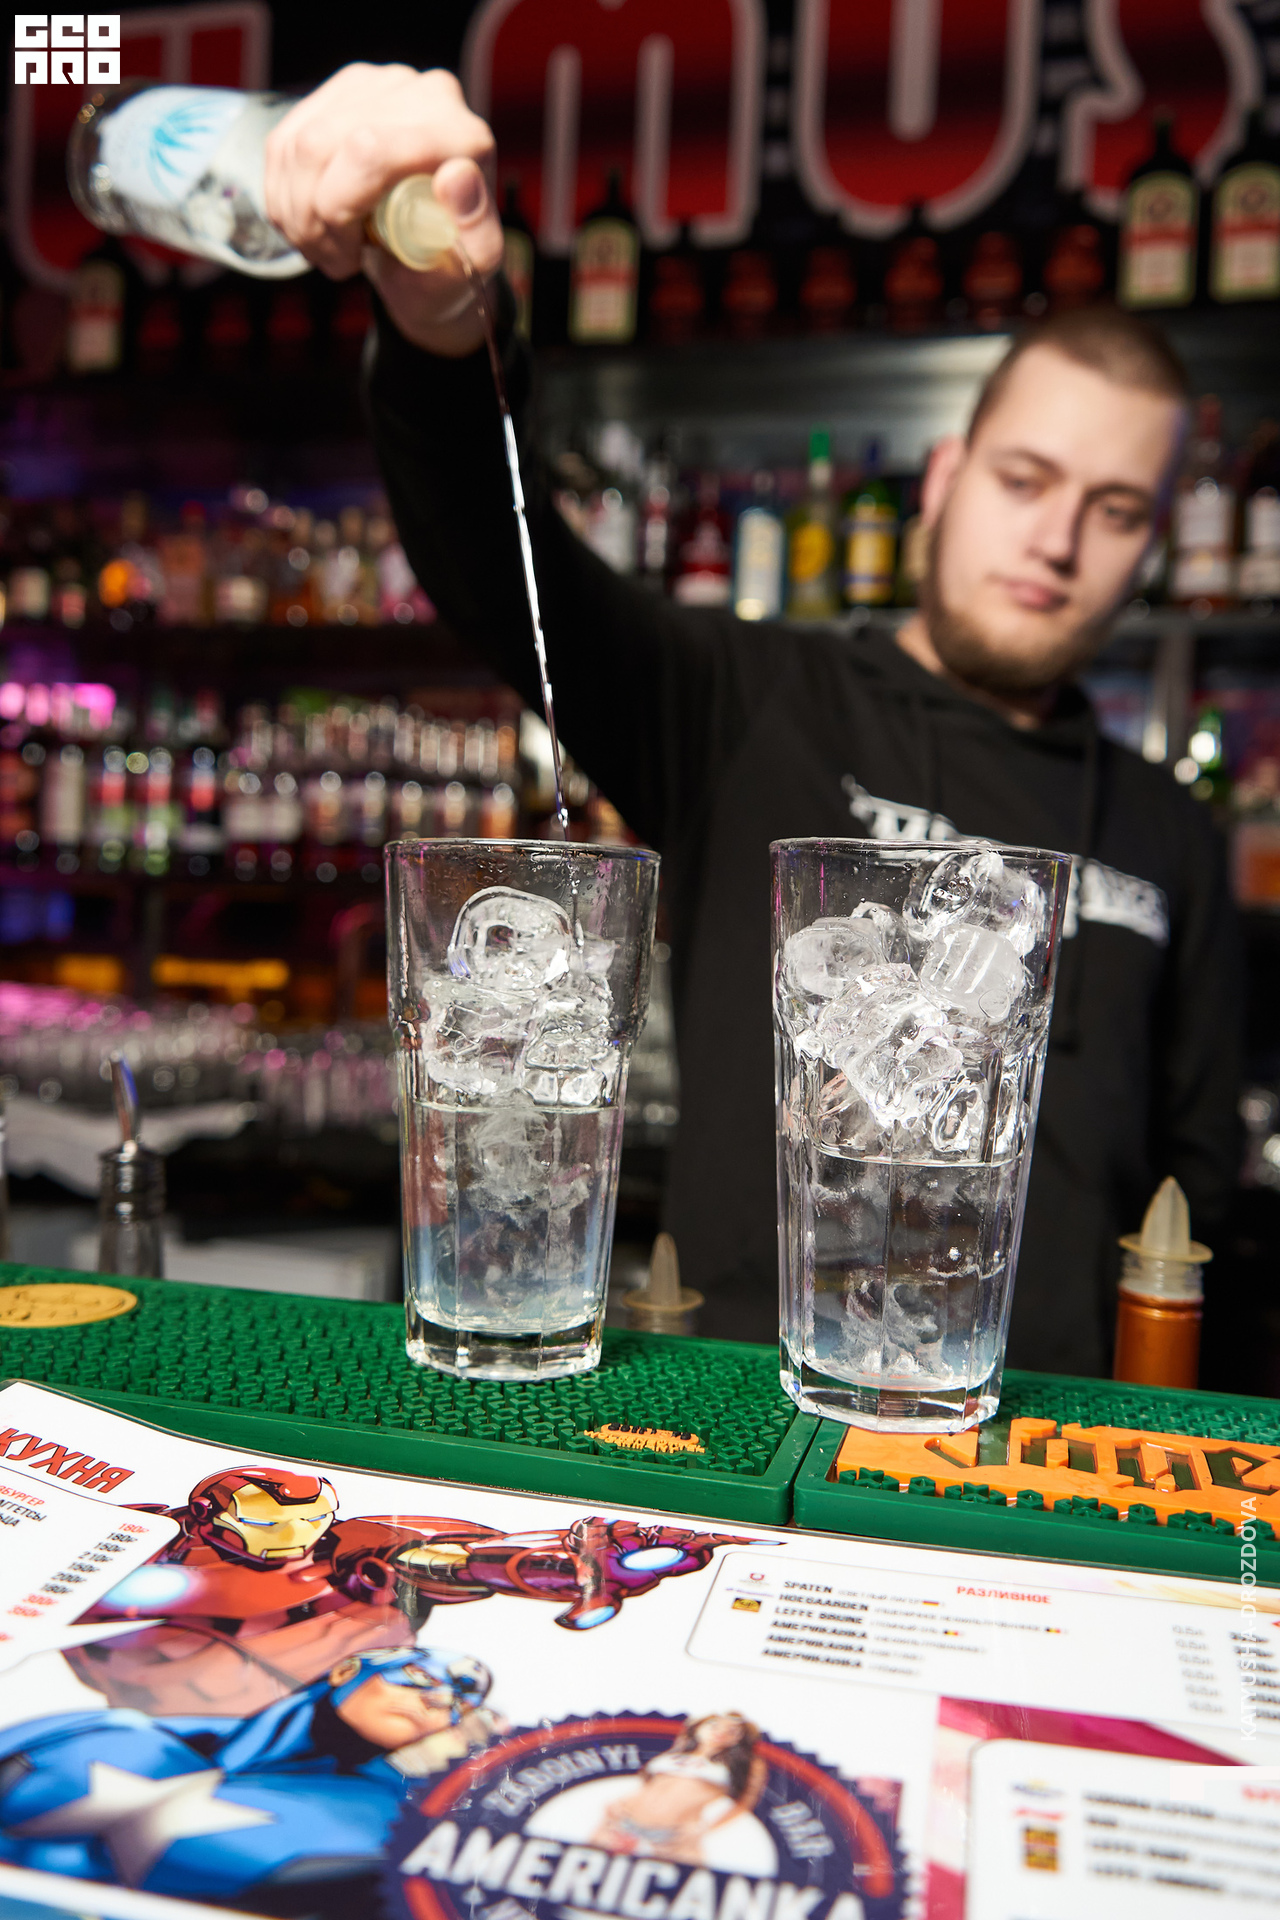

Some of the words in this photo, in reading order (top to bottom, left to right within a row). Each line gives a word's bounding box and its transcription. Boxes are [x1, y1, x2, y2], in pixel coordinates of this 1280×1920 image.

[0, 1428, 135, 1493] КУХНЯ
[784, 1581, 832, 1593] SPATEN
[956, 1585, 1052, 1604] РАЗЛИВНОЕ
[779, 1594, 868, 1611] HOEGAARDEN
[775, 1606, 814, 1618] LEFFE
